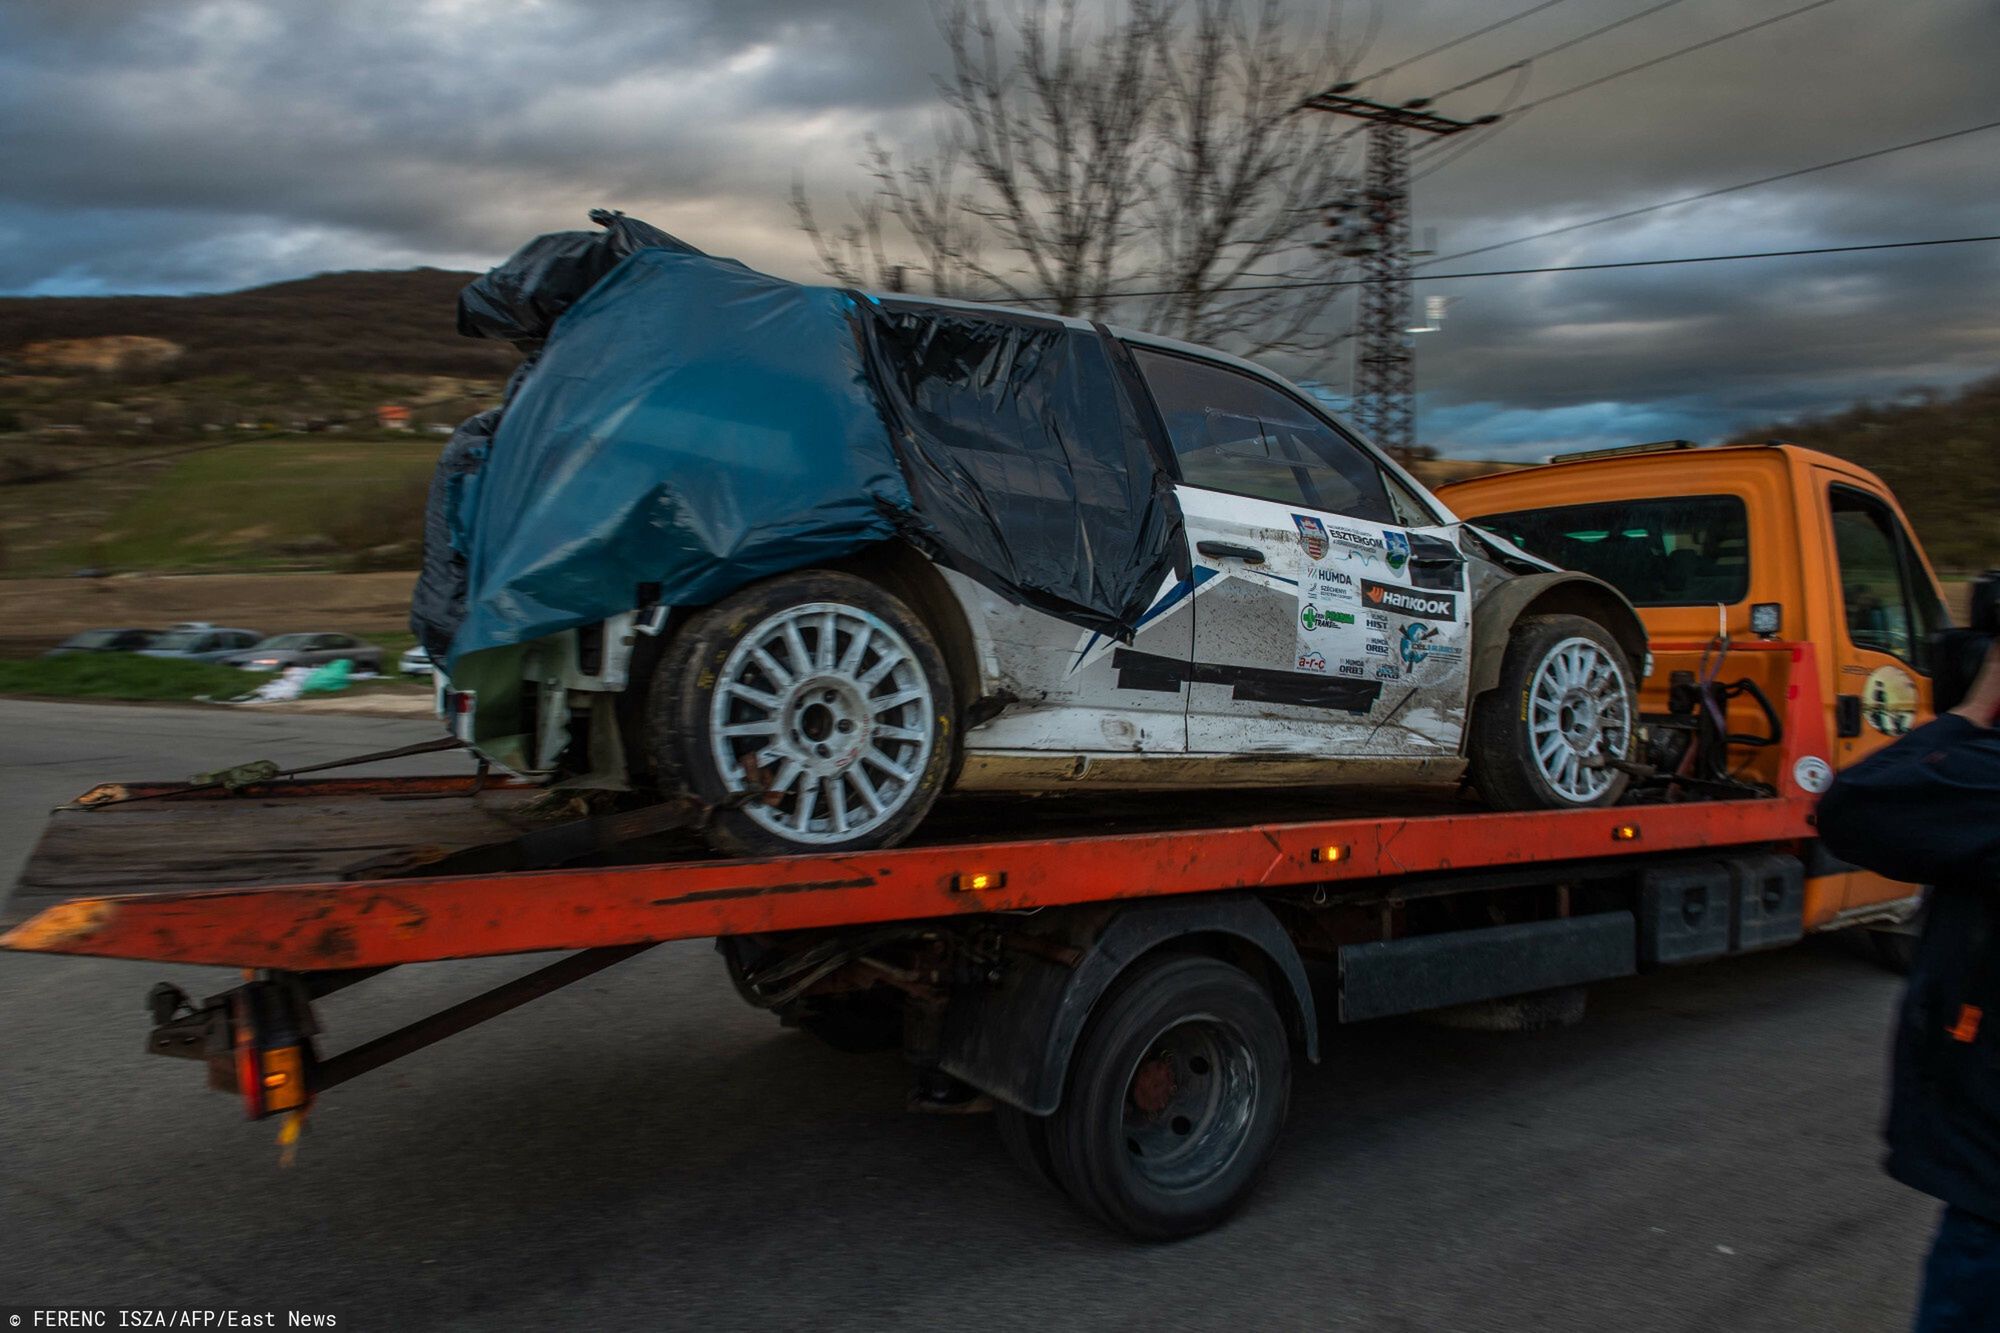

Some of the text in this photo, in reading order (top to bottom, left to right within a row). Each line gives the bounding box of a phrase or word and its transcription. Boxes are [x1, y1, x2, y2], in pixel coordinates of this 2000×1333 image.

[1319, 569, 1352, 585] HUMDA
[1366, 619, 1388, 630] HIST
[1366, 643, 1389, 654] ORB2
[1339, 664, 1364, 676] ORB3
